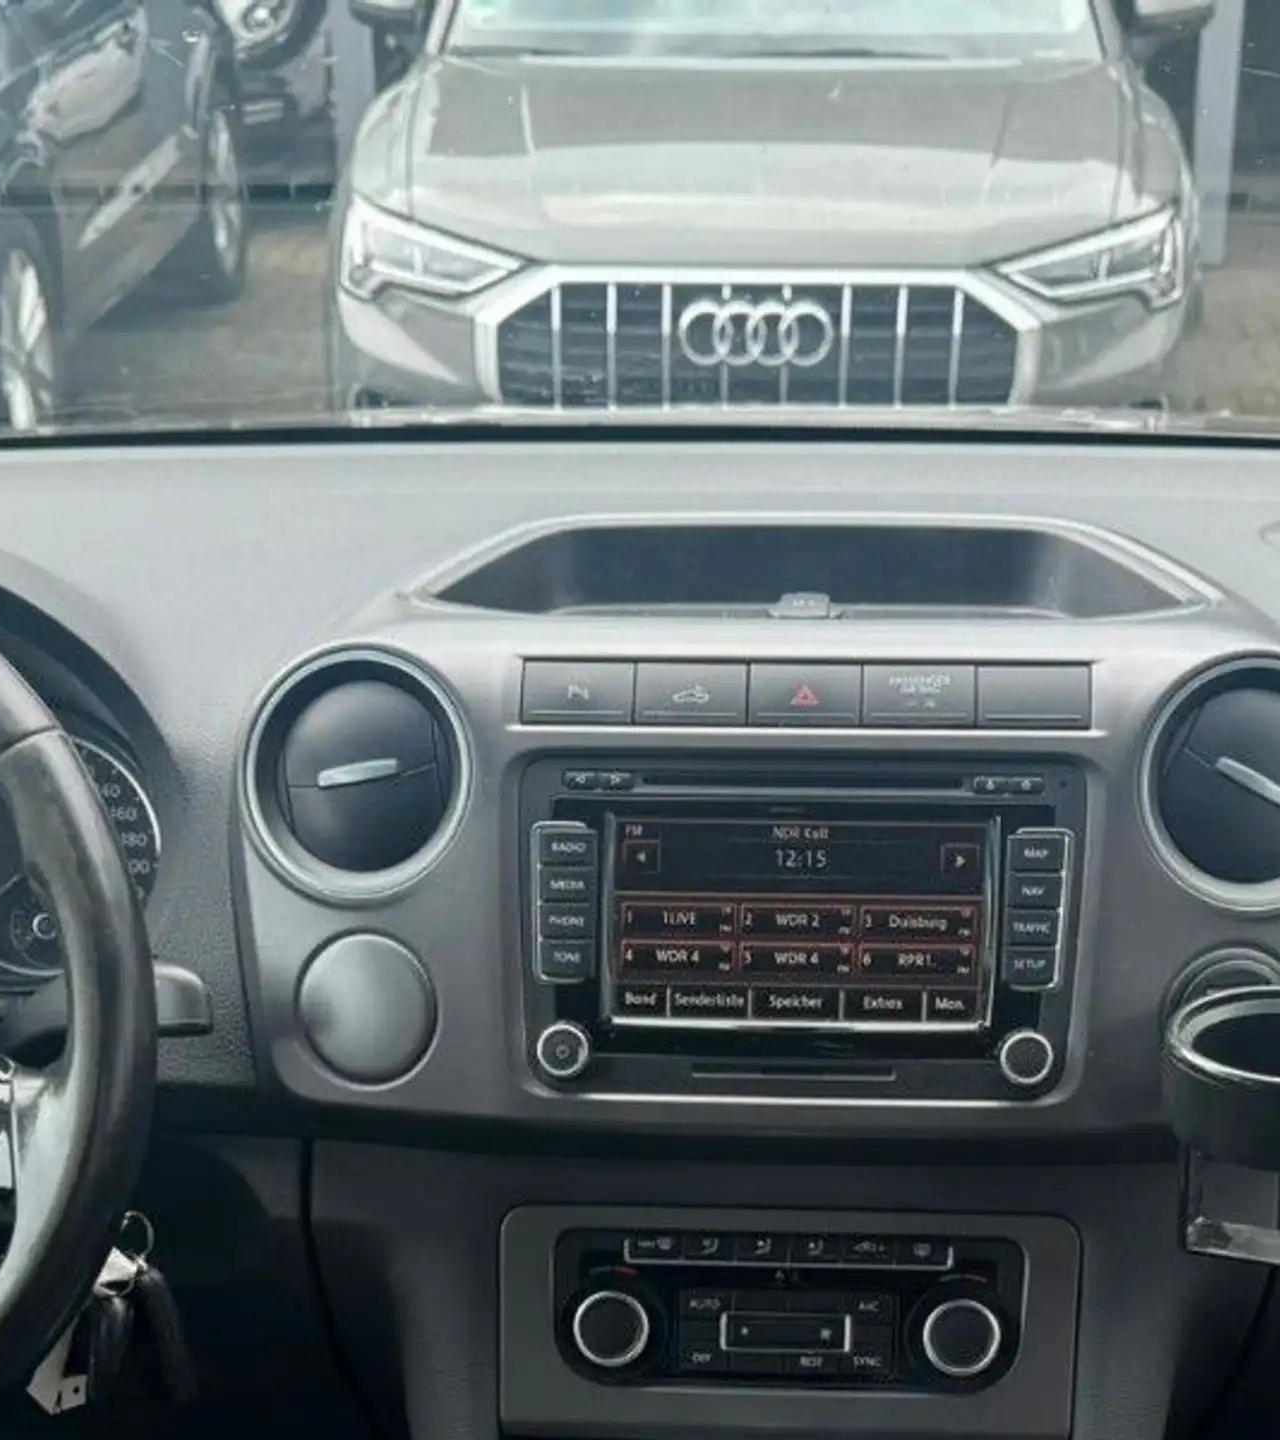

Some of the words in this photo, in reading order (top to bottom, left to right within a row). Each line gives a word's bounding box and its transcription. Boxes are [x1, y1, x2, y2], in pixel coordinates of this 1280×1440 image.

[551, 842, 586, 853] RADIO
[775, 849, 827, 868] 12:15
[128, 859, 150, 874] 00
[549, 879, 585, 890] MEDIA
[1022, 886, 1045, 896] NAV
[548, 915, 584, 927] PHONE
[776, 913, 809, 927] WDR
[811, 913, 820, 928] 2
[889, 914, 948, 931] Duisburg
[553, 951, 581, 963] TONE
[655, 949, 689, 962] WDR
[690, 950, 699, 963] 4
[774, 951, 807, 965] WDR
[625, 991, 657, 1006] Band
[674, 992, 745, 1007] Senderliste
[769, 994, 822, 1010] Speicher
[863, 996, 903, 1010] Extras
[688, 1299, 721, 1310] AUTO
